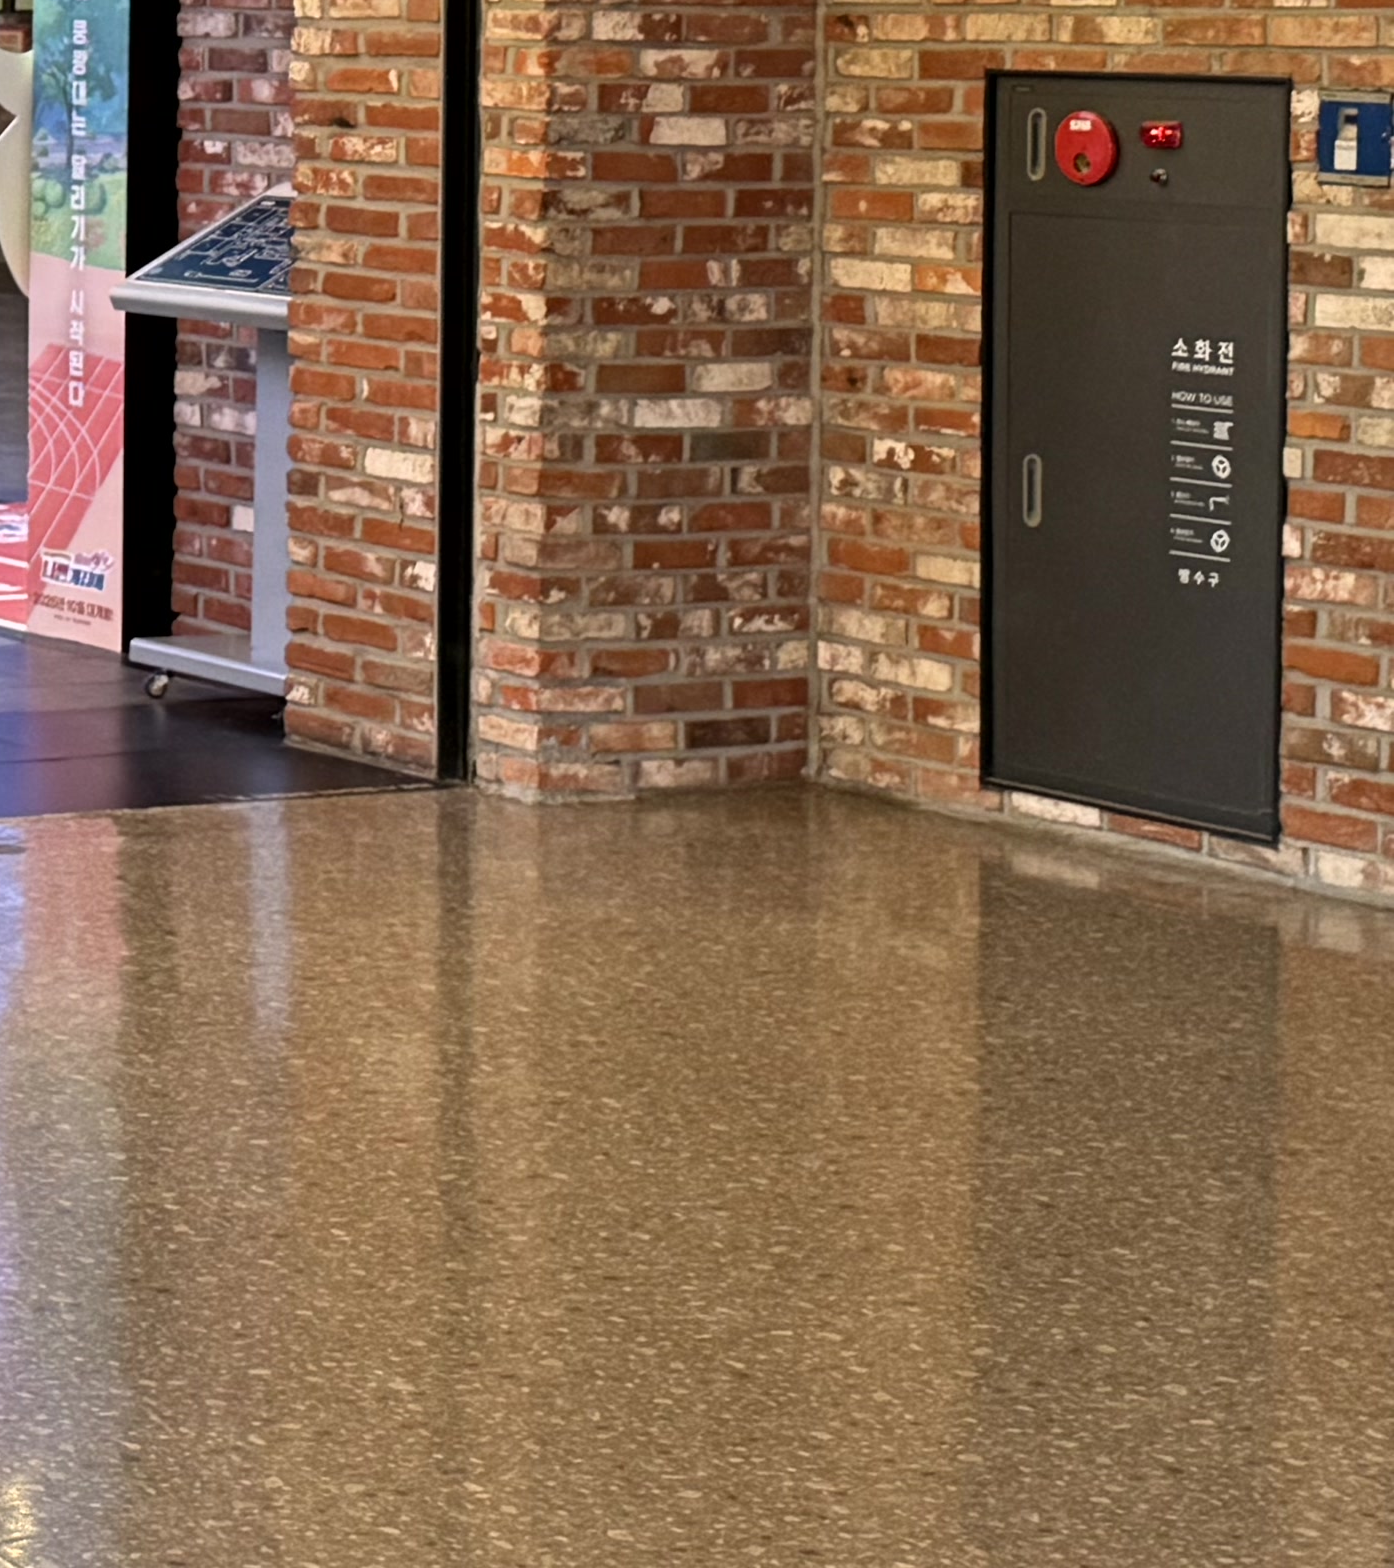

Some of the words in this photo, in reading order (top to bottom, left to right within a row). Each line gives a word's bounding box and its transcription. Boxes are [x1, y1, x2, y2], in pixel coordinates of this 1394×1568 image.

[1171, 337, 1234, 364] 소화전
[1171, 391, 1197, 403] HOW
[1198, 392, 1213, 405] TO
[1214, 395, 1233, 408] USE
